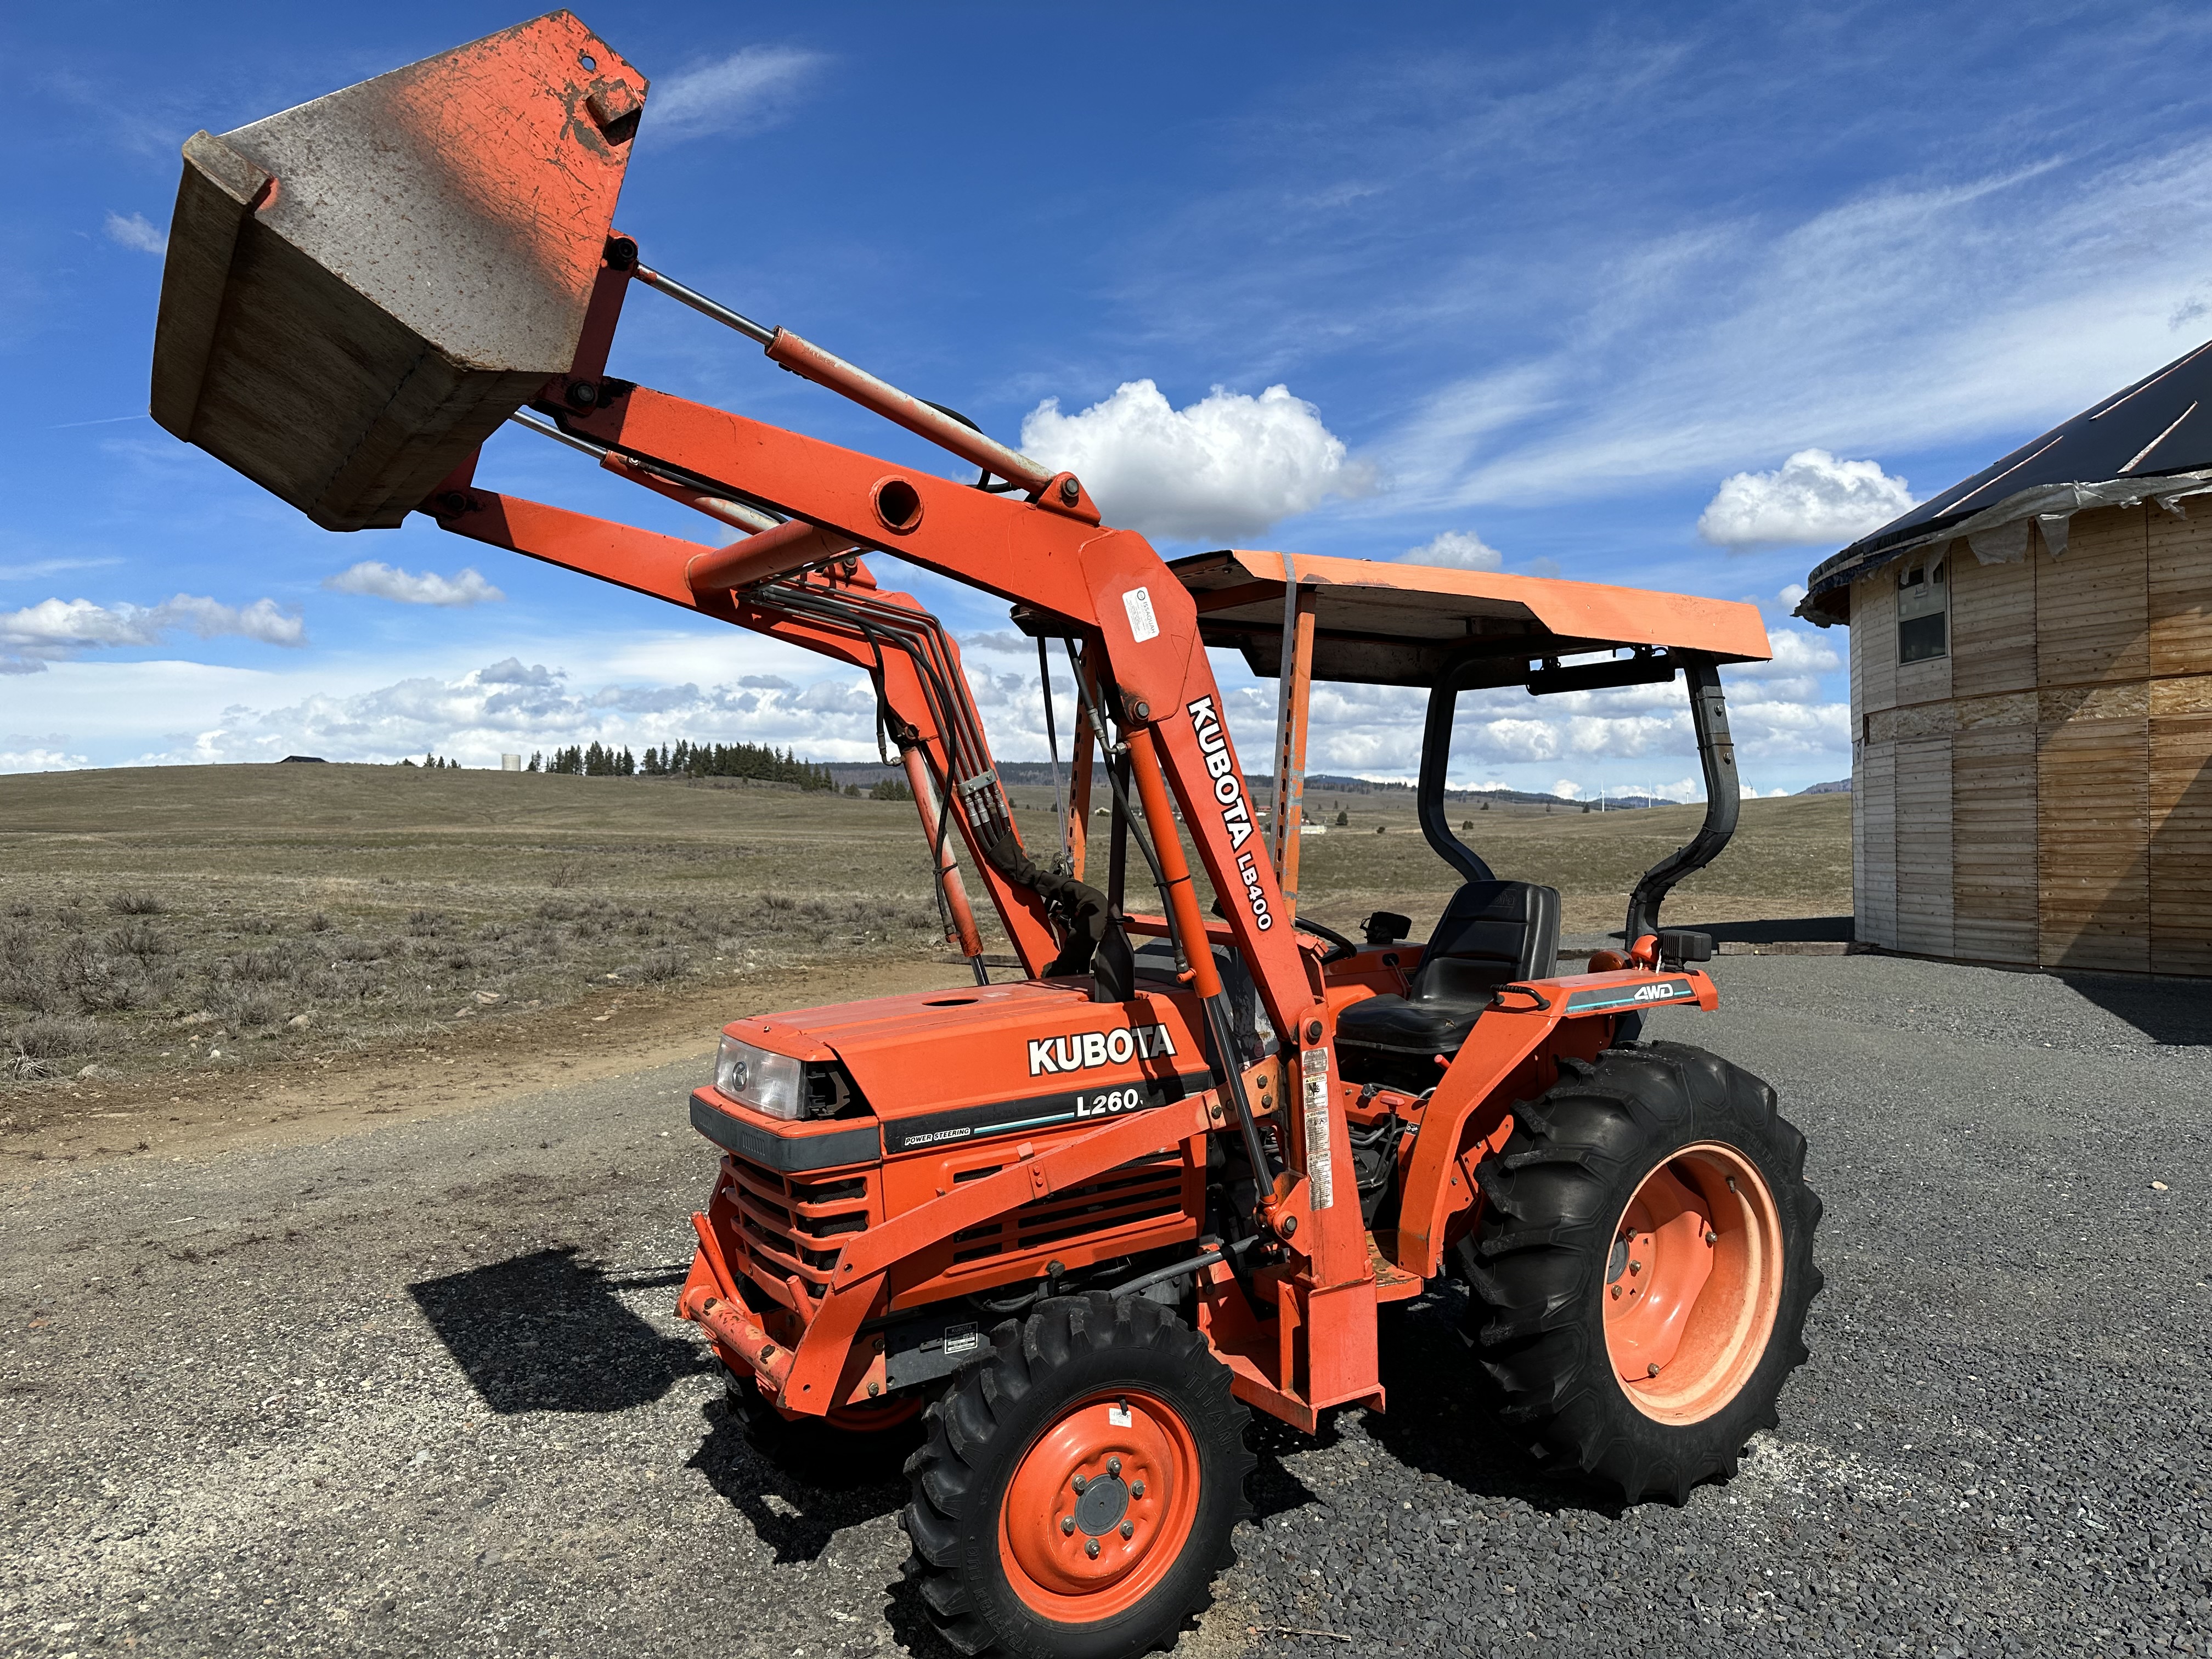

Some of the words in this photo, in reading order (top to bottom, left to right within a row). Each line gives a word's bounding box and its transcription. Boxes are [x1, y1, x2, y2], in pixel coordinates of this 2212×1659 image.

[1143, 601, 1156, 634] ISSAQUAH
[1187, 695, 1254, 852] KUBOTA
[1237, 851, 1272, 930] LB400
[1634, 983, 1674, 1000] 4WD
[1028, 1023, 1177, 1076] KUBOTA
[1077, 1088, 1143, 1117] L260
[905, 1133, 933, 1146] POWER
[933, 1127, 970, 1141] STEERING
[952, 1325, 972, 1333] KUBOTA
[1185, 1370, 1235, 1447] TITAN
[966, 1546, 985, 1583] LUG
